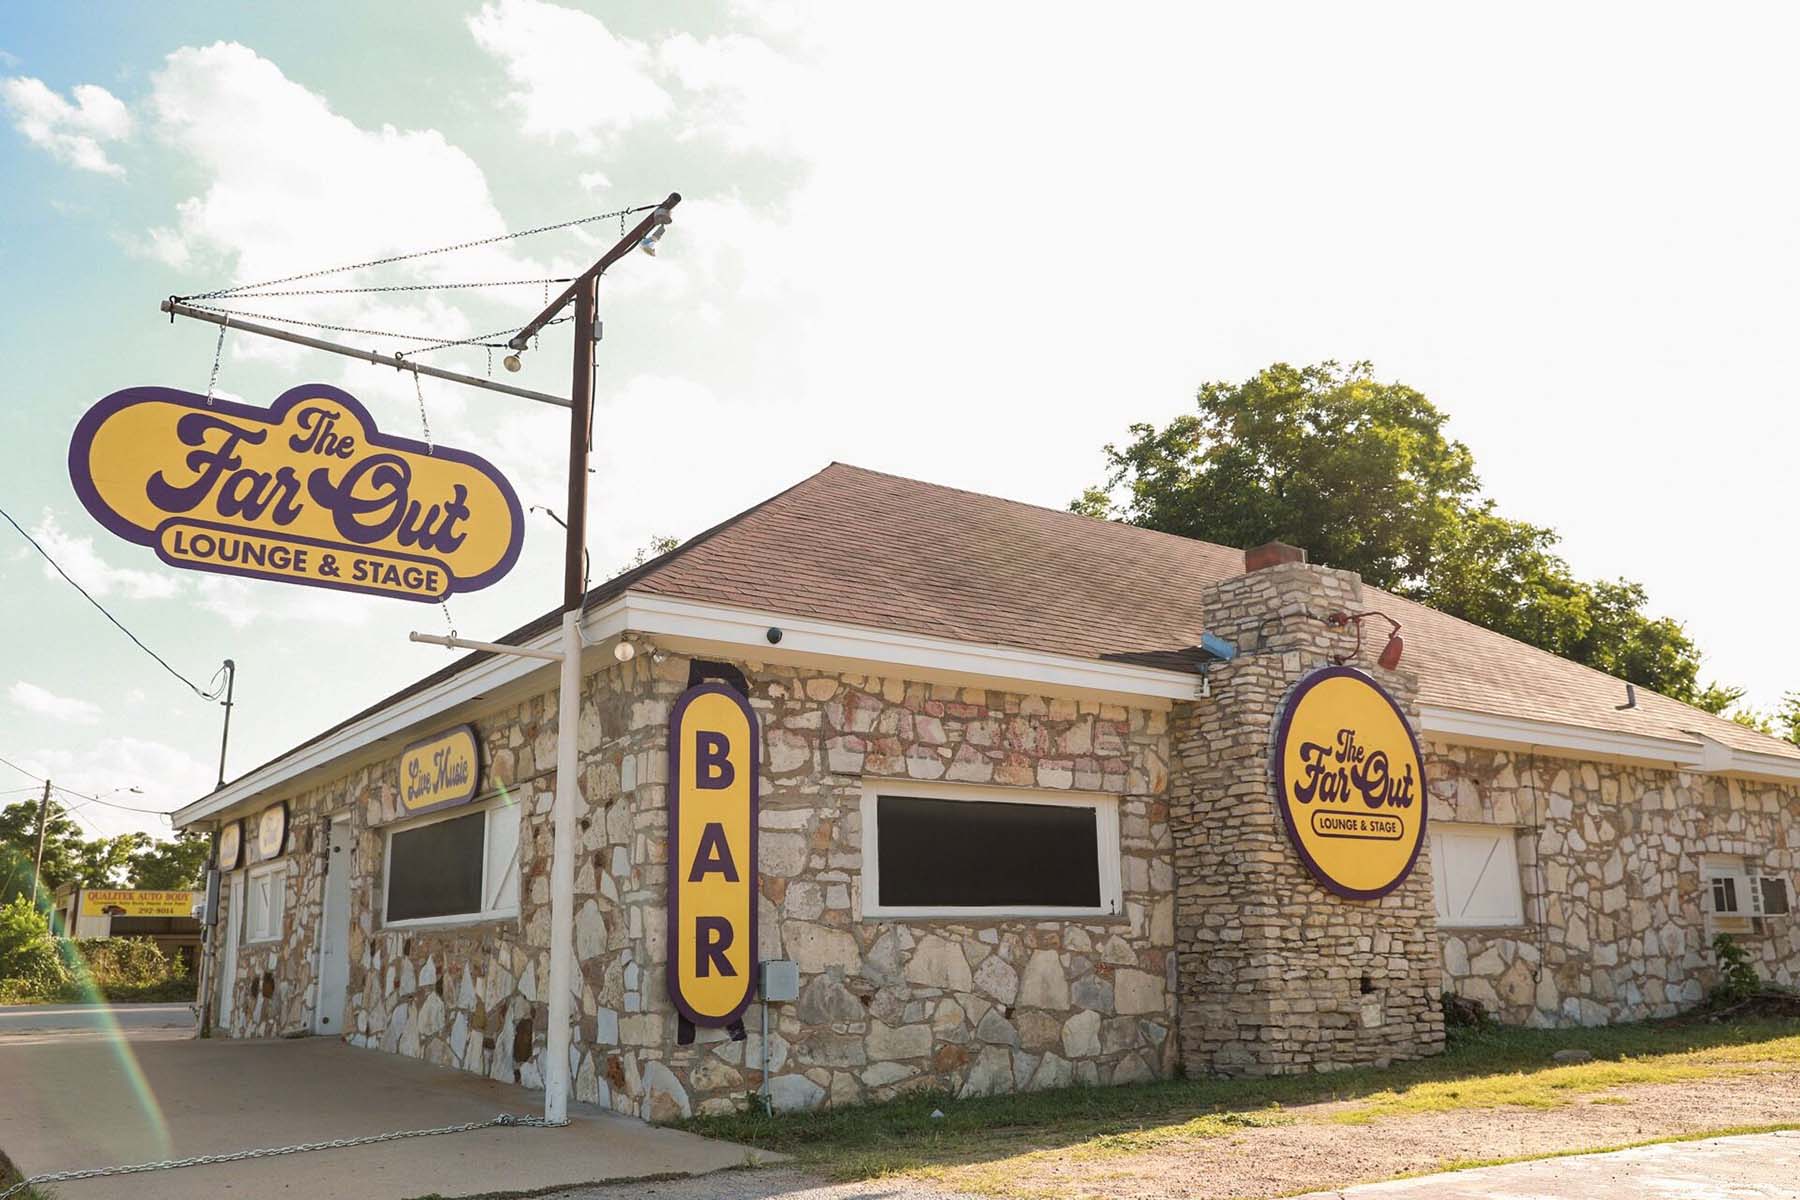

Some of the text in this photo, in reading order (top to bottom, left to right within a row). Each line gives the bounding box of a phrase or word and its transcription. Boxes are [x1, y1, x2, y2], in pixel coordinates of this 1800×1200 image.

[289, 407, 354, 459] The
[146, 413, 470, 554] Far Out
[173, 531, 439, 592] LOUNGE & STAGE
[408, 745, 468, 801] Live Music
[1335, 728, 1364, 763] The
[1294, 741, 1415, 809] Far Out
[1319, 817, 1396, 833] LOUNGE & STAGE
[688, 730, 740, 977] BAR
[139, 892, 162, 901] AUTO
[165, 892, 190, 901] BODY
